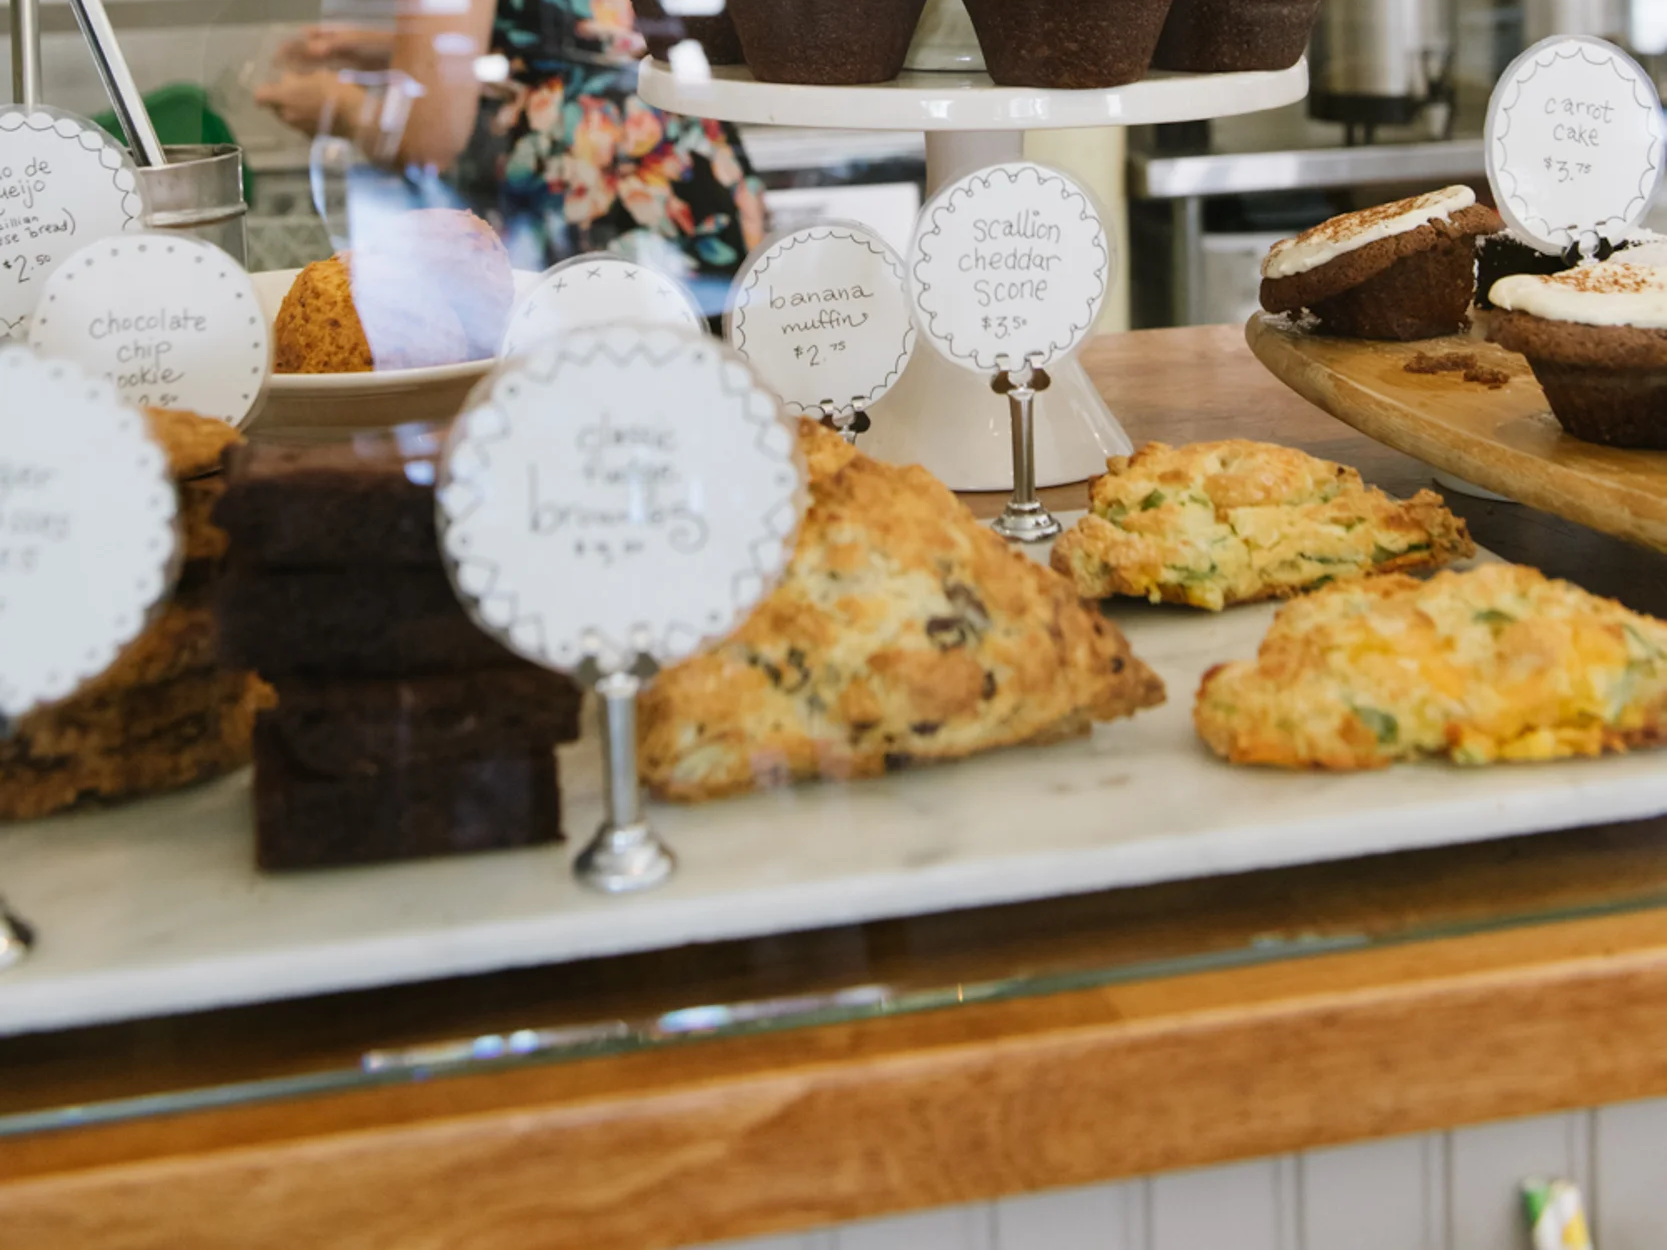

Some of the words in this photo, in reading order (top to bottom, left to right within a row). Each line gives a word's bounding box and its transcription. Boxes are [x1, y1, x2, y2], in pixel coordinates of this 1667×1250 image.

[1545, 97, 1615, 123] carrot
[1553, 123, 1600, 147] cake
[24, 156, 52, 177] de
[958, 246, 1062, 272] cheddar
[769, 284, 874, 310] banana
[781, 309, 869, 334] muffin
[116, 338, 173, 371] chip
